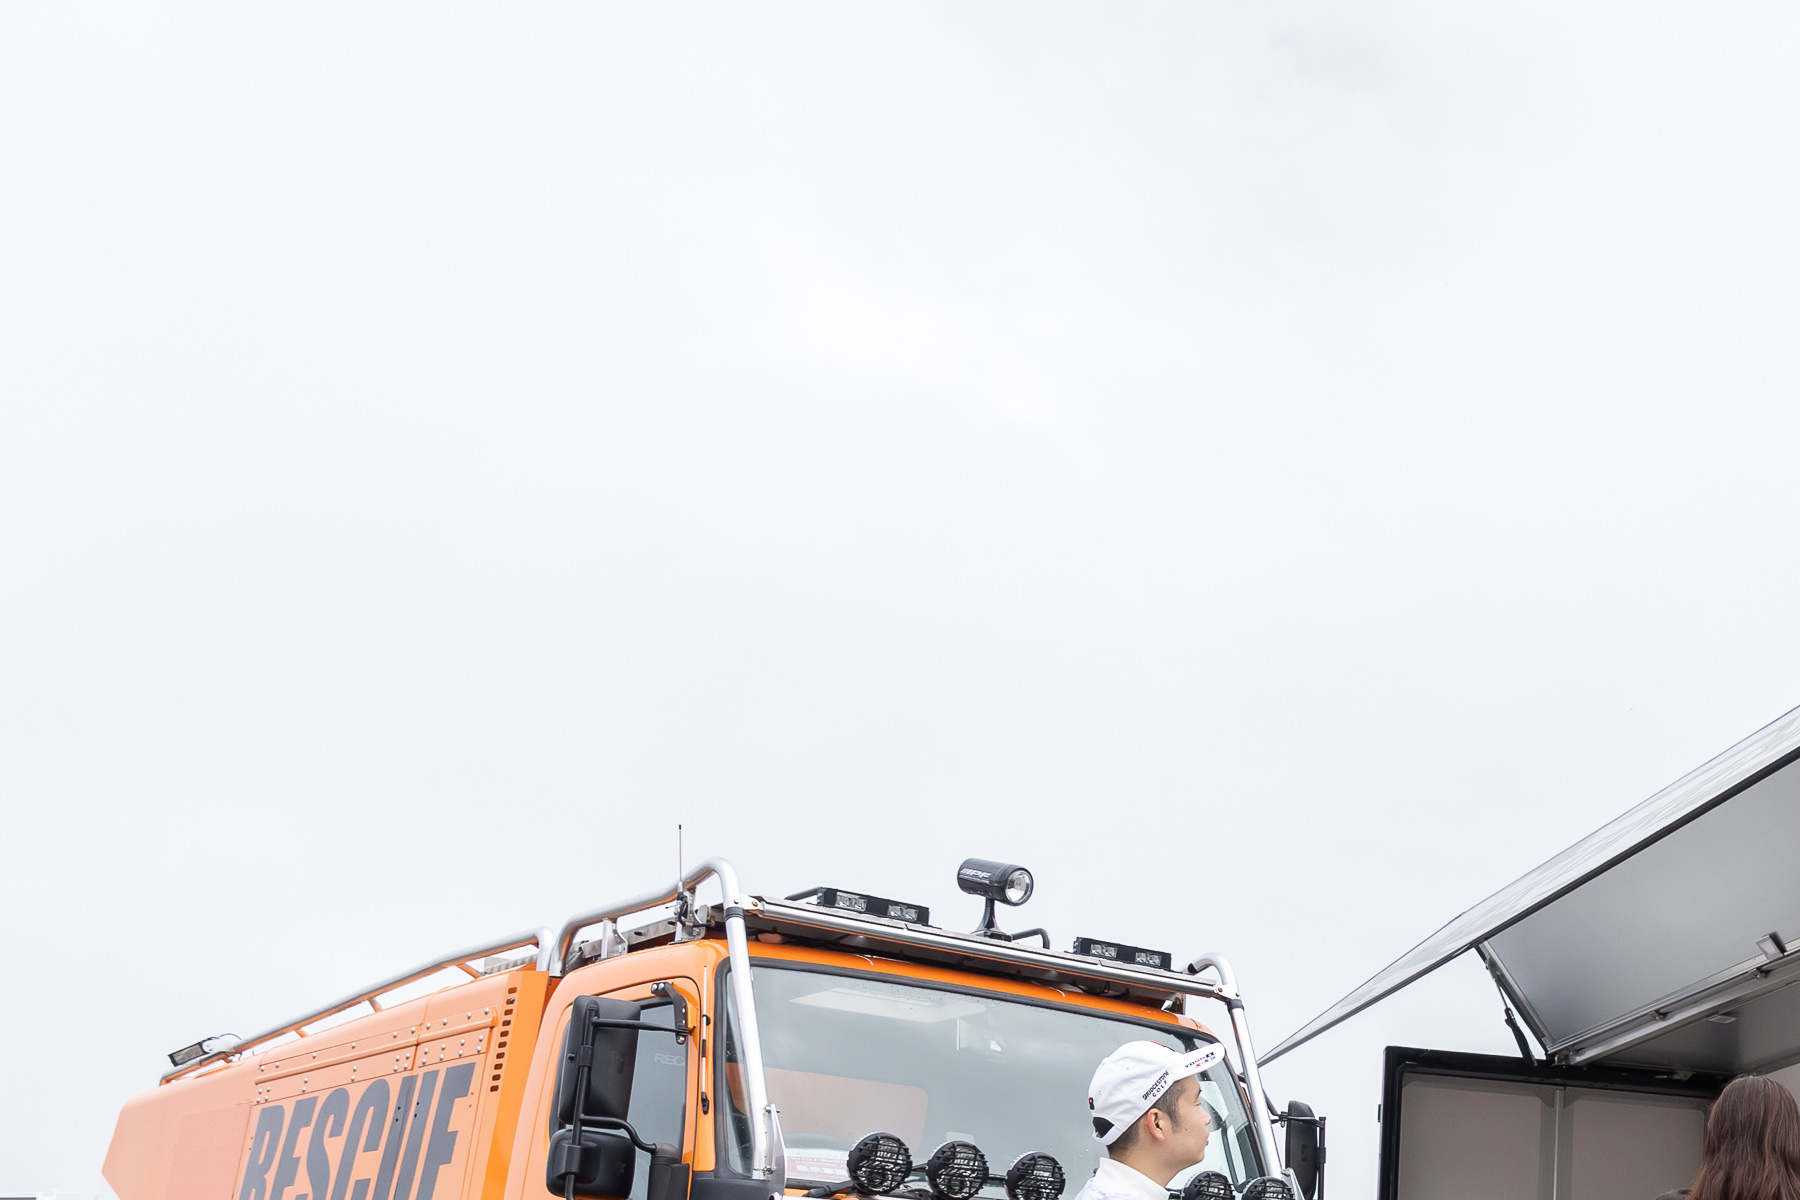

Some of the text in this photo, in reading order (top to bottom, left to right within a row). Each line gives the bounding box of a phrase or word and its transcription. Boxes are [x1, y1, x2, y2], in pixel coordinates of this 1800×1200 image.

[654, 1052, 686, 1067] REC
[1142, 1070, 1170, 1100] BRIDGESTONE
[1152, 1079, 1168, 1098] GOLF
